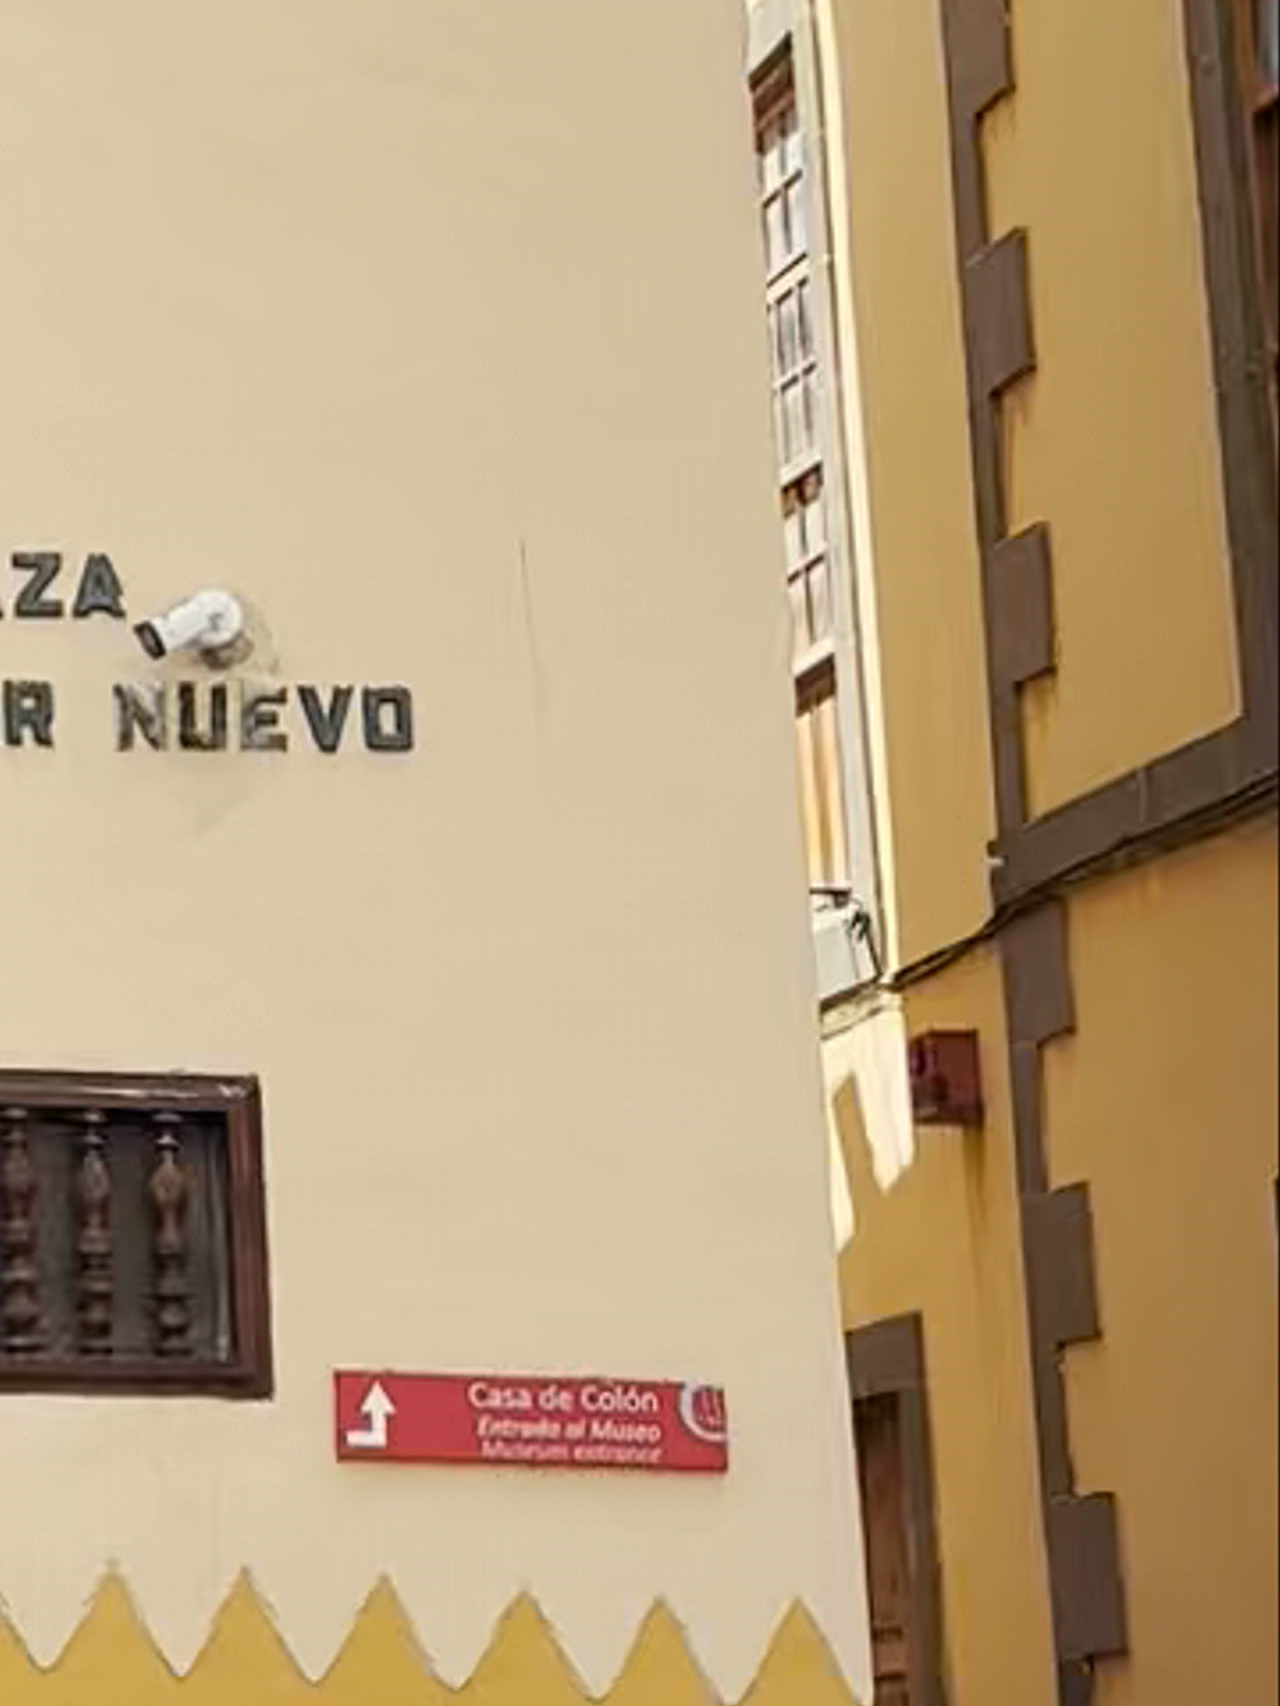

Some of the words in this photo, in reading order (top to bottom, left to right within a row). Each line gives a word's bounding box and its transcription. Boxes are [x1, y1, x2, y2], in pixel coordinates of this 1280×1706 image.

[113, 681, 416, 754] NUEVO
[468, 1383, 533, 1409] Casa
[538, 1383, 572, 1410] de
[581, 1384, 658, 1412] Colón
[477, 1415, 561, 1439] Entrada
[565, 1418, 587, 1440] al
[589, 1418, 661, 1442] Museo
